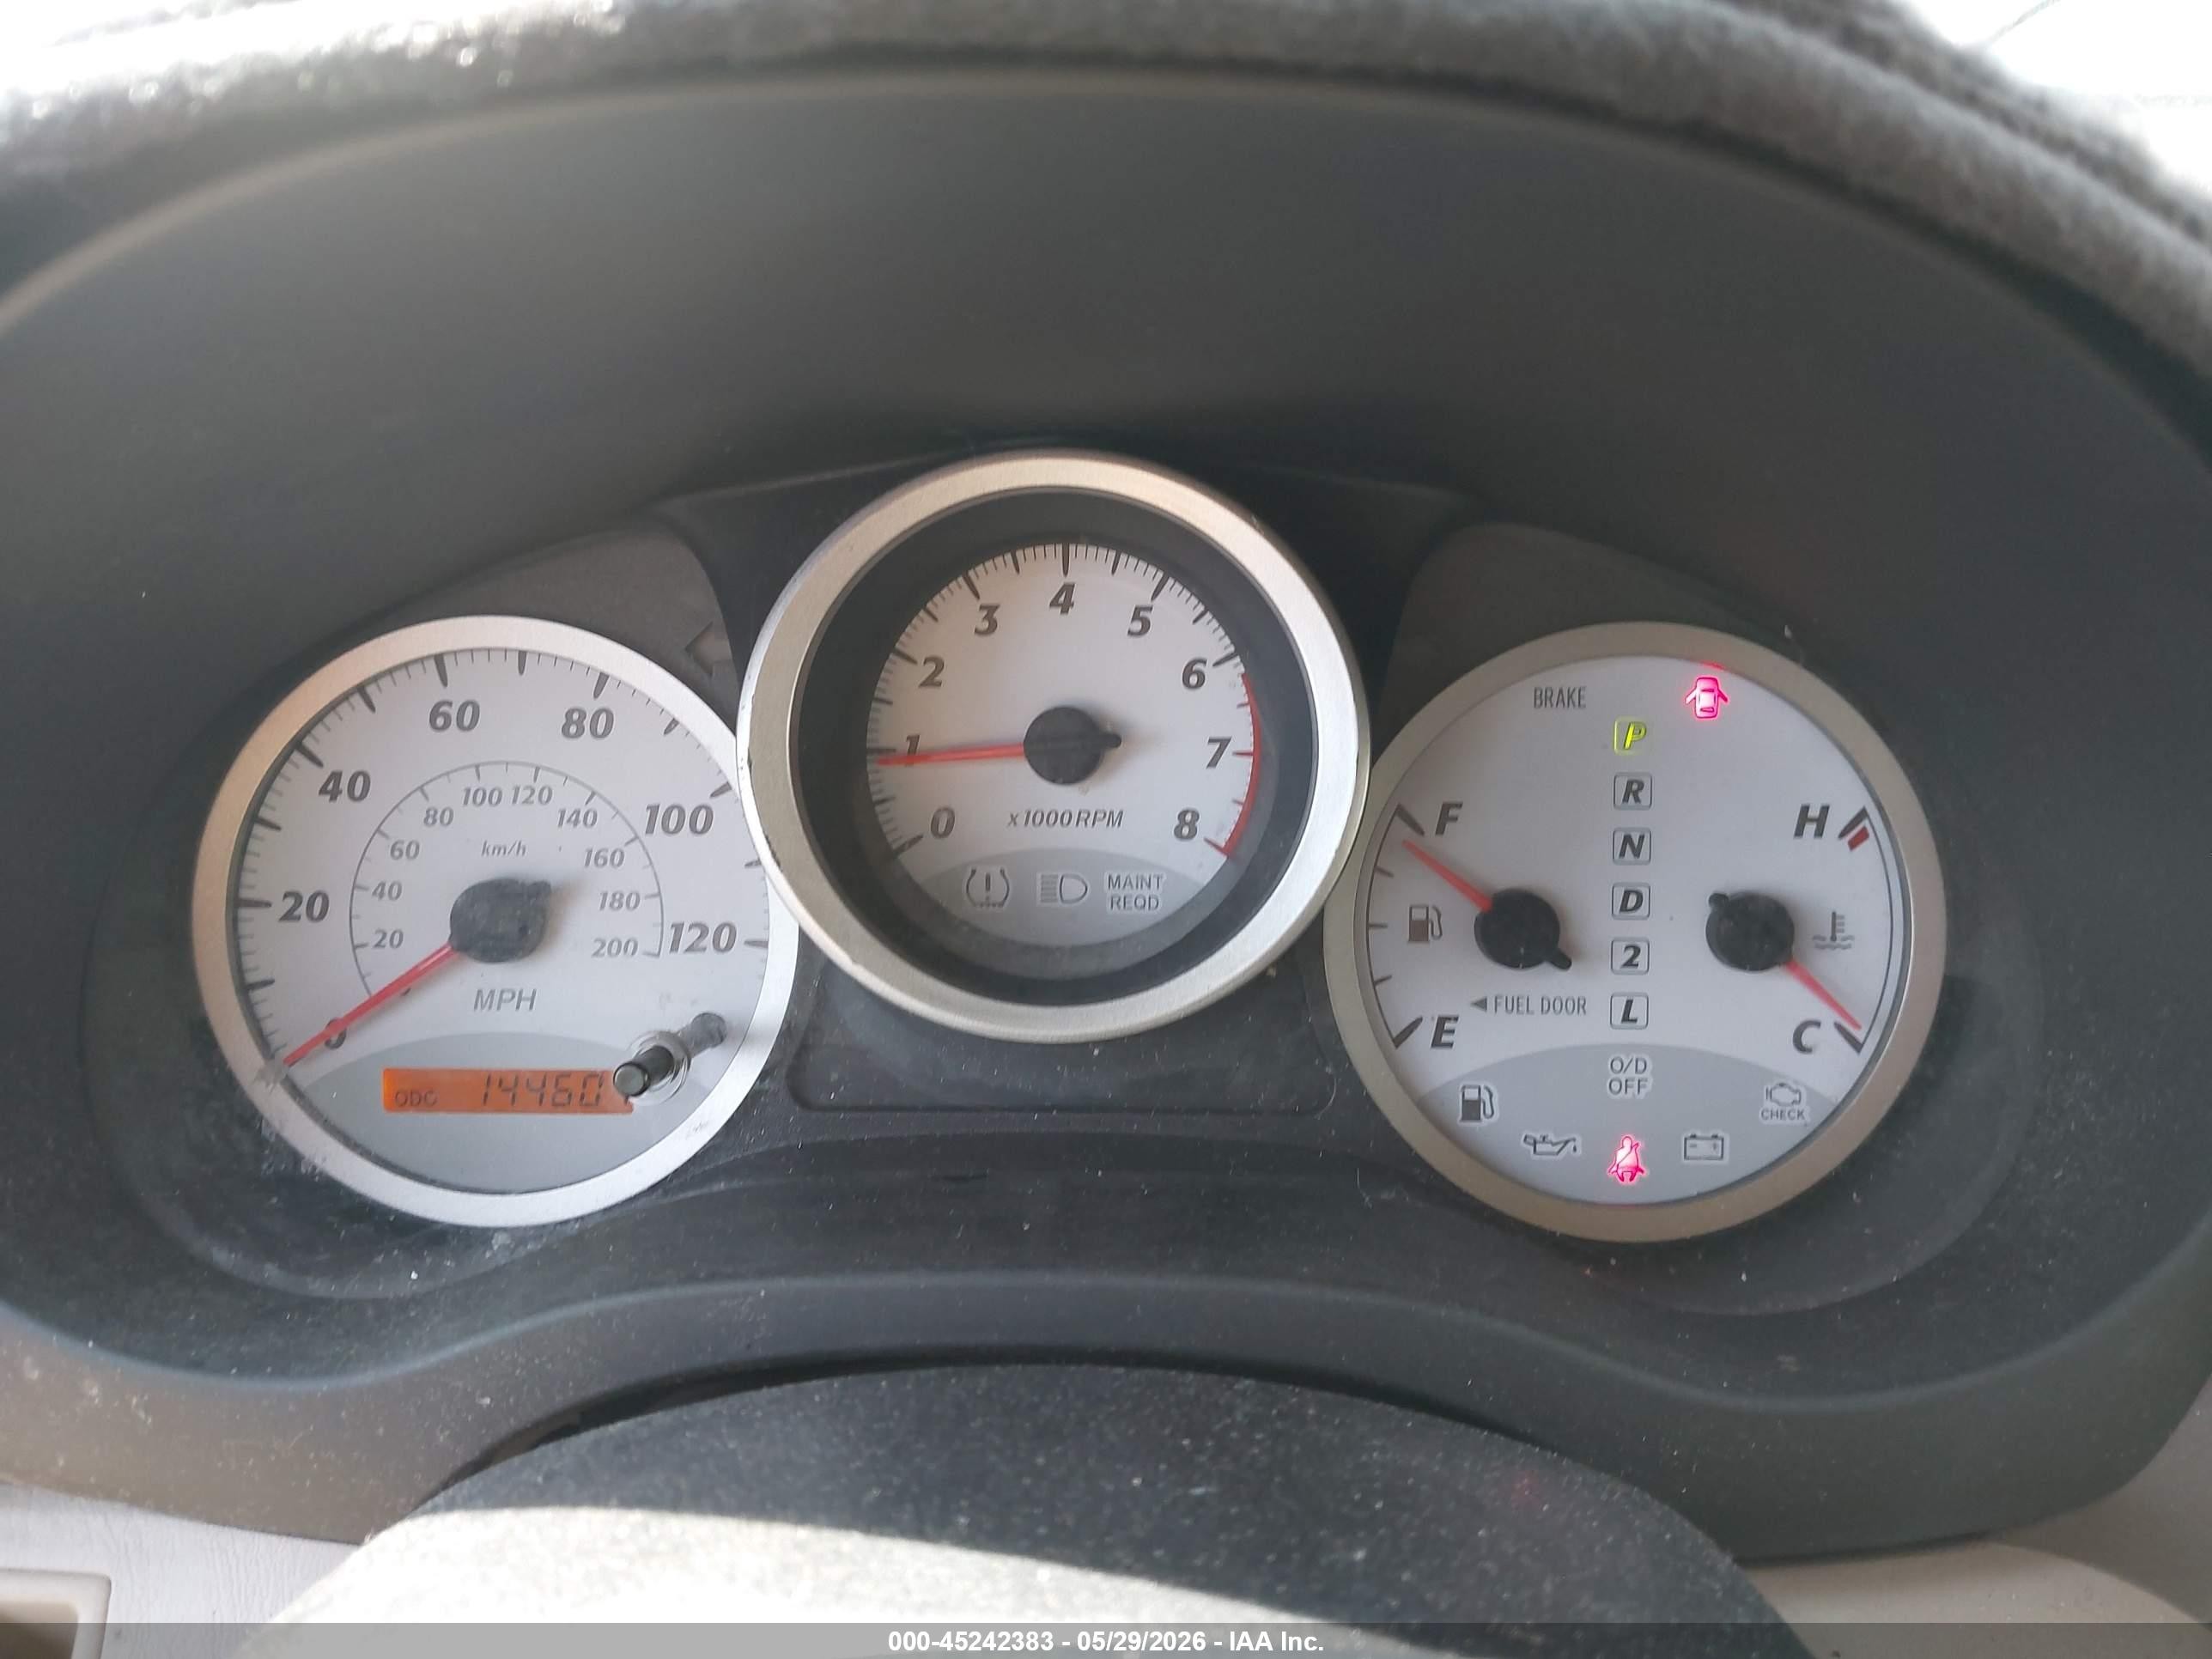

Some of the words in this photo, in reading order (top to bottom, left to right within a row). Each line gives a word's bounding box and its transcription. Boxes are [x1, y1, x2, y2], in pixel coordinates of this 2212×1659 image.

[1049, 583, 1076, 615] 4
[974, 605, 1000, 636] 3
[1127, 605, 1153, 637] 5
[918, 656, 945, 688] 2
[1182, 658, 1207, 690] 6
[1533, 687, 1587, 709] BRAKE
[428, 701, 480, 732] 60
[561, 708, 615, 738] 80
[1623, 721, 1647, 750] P
[905, 734, 920, 767] 1
[1206, 738, 1231, 769] 7
[318, 770, 371, 803] 40
[462, 787, 503, 807] 100
[511, 785, 553, 805] 120
[1620, 780, 1645, 805] R
[422, 806, 454, 827] 80
[557, 808, 598, 829] 140
[645, 804, 714, 836] 100
[930, 807, 955, 839] 0
[1174, 808, 1200, 841] 8
[1435, 801, 1462, 836] F
[1793, 804, 1830, 839] H
[390, 840, 420, 860] 60
[481, 841, 526, 859] km/h
[584, 848, 624, 868] 160
[1619, 835, 1644, 860] N
[372, 882, 402, 901] 40
[1108, 874, 1162, 890] MAINT
[278, 891, 330, 922] 20
[599, 891, 641, 911] 180
[1110, 894, 1160, 911] REQD
[1619, 889, 1644, 915] D
[374, 929, 404, 950] 20
[591, 937, 639, 958] 200
[667, 922, 738, 955] 120
[1620, 944, 1642, 969] 2
[473, 990, 537, 1012] MPH
[1494, 995, 1535, 1014] FUEL
[1540, 995, 1587, 1015] DOOR
[1620, 999, 1638, 1024] L
[1431, 1017, 1459, 1048] E
[1792, 1020, 1821, 1054] C
[1609, 1056, 1648, 1075] O/D
[483, 1073, 630, 1106] 14460
[1608, 1077, 1648, 1096] OFF
[1760, 1107, 1805, 1121] CHECK
